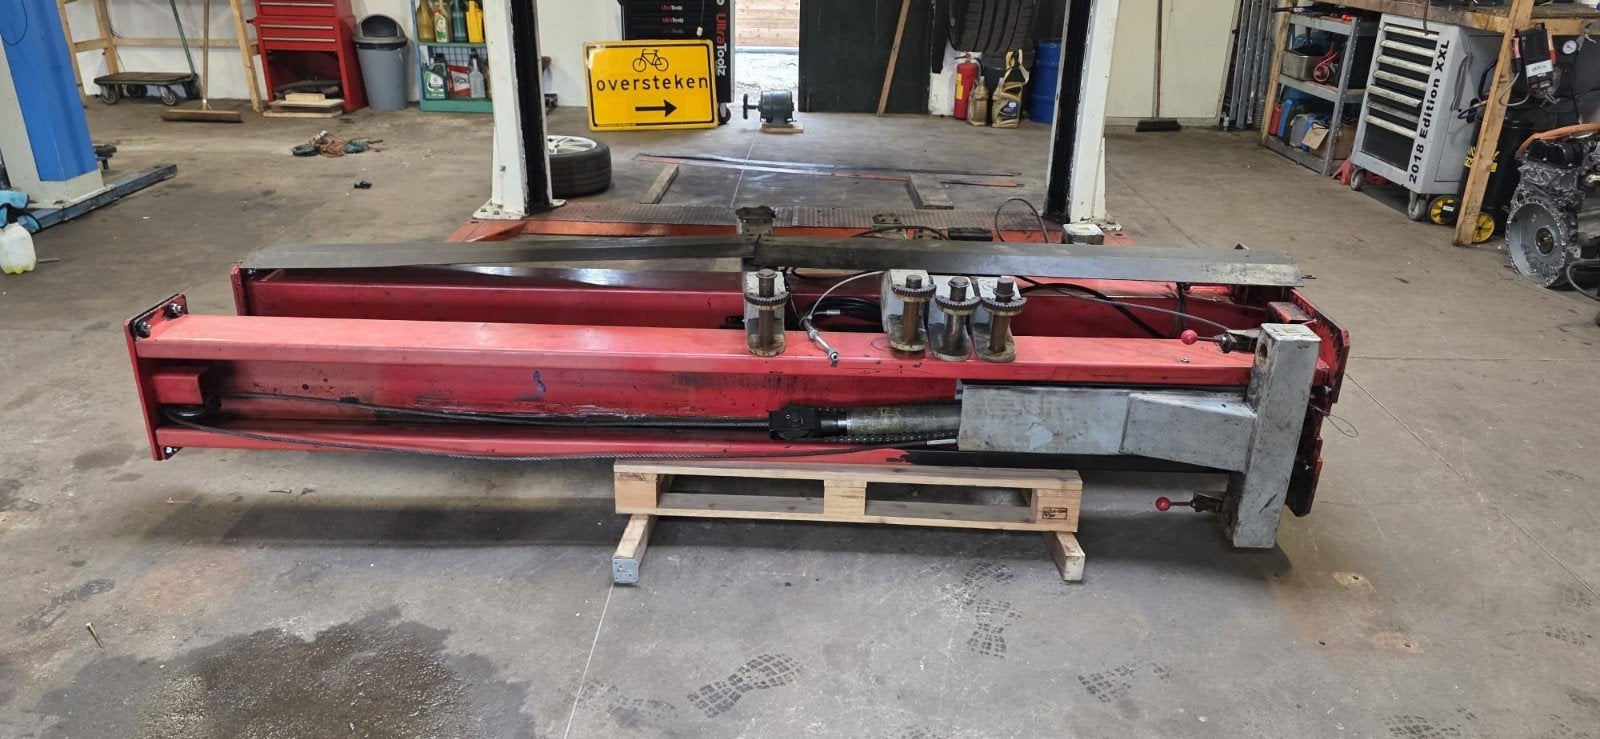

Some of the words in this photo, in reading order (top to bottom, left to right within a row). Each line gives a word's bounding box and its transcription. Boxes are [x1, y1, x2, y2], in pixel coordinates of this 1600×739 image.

[716, 13, 727, 76] UltraToolz
[596, 74, 708, 92] oversteken
[1409, 143, 1425, 184] 2018
[1419, 78, 1441, 139] Edition
[1434, 40, 1450, 73] XXL
